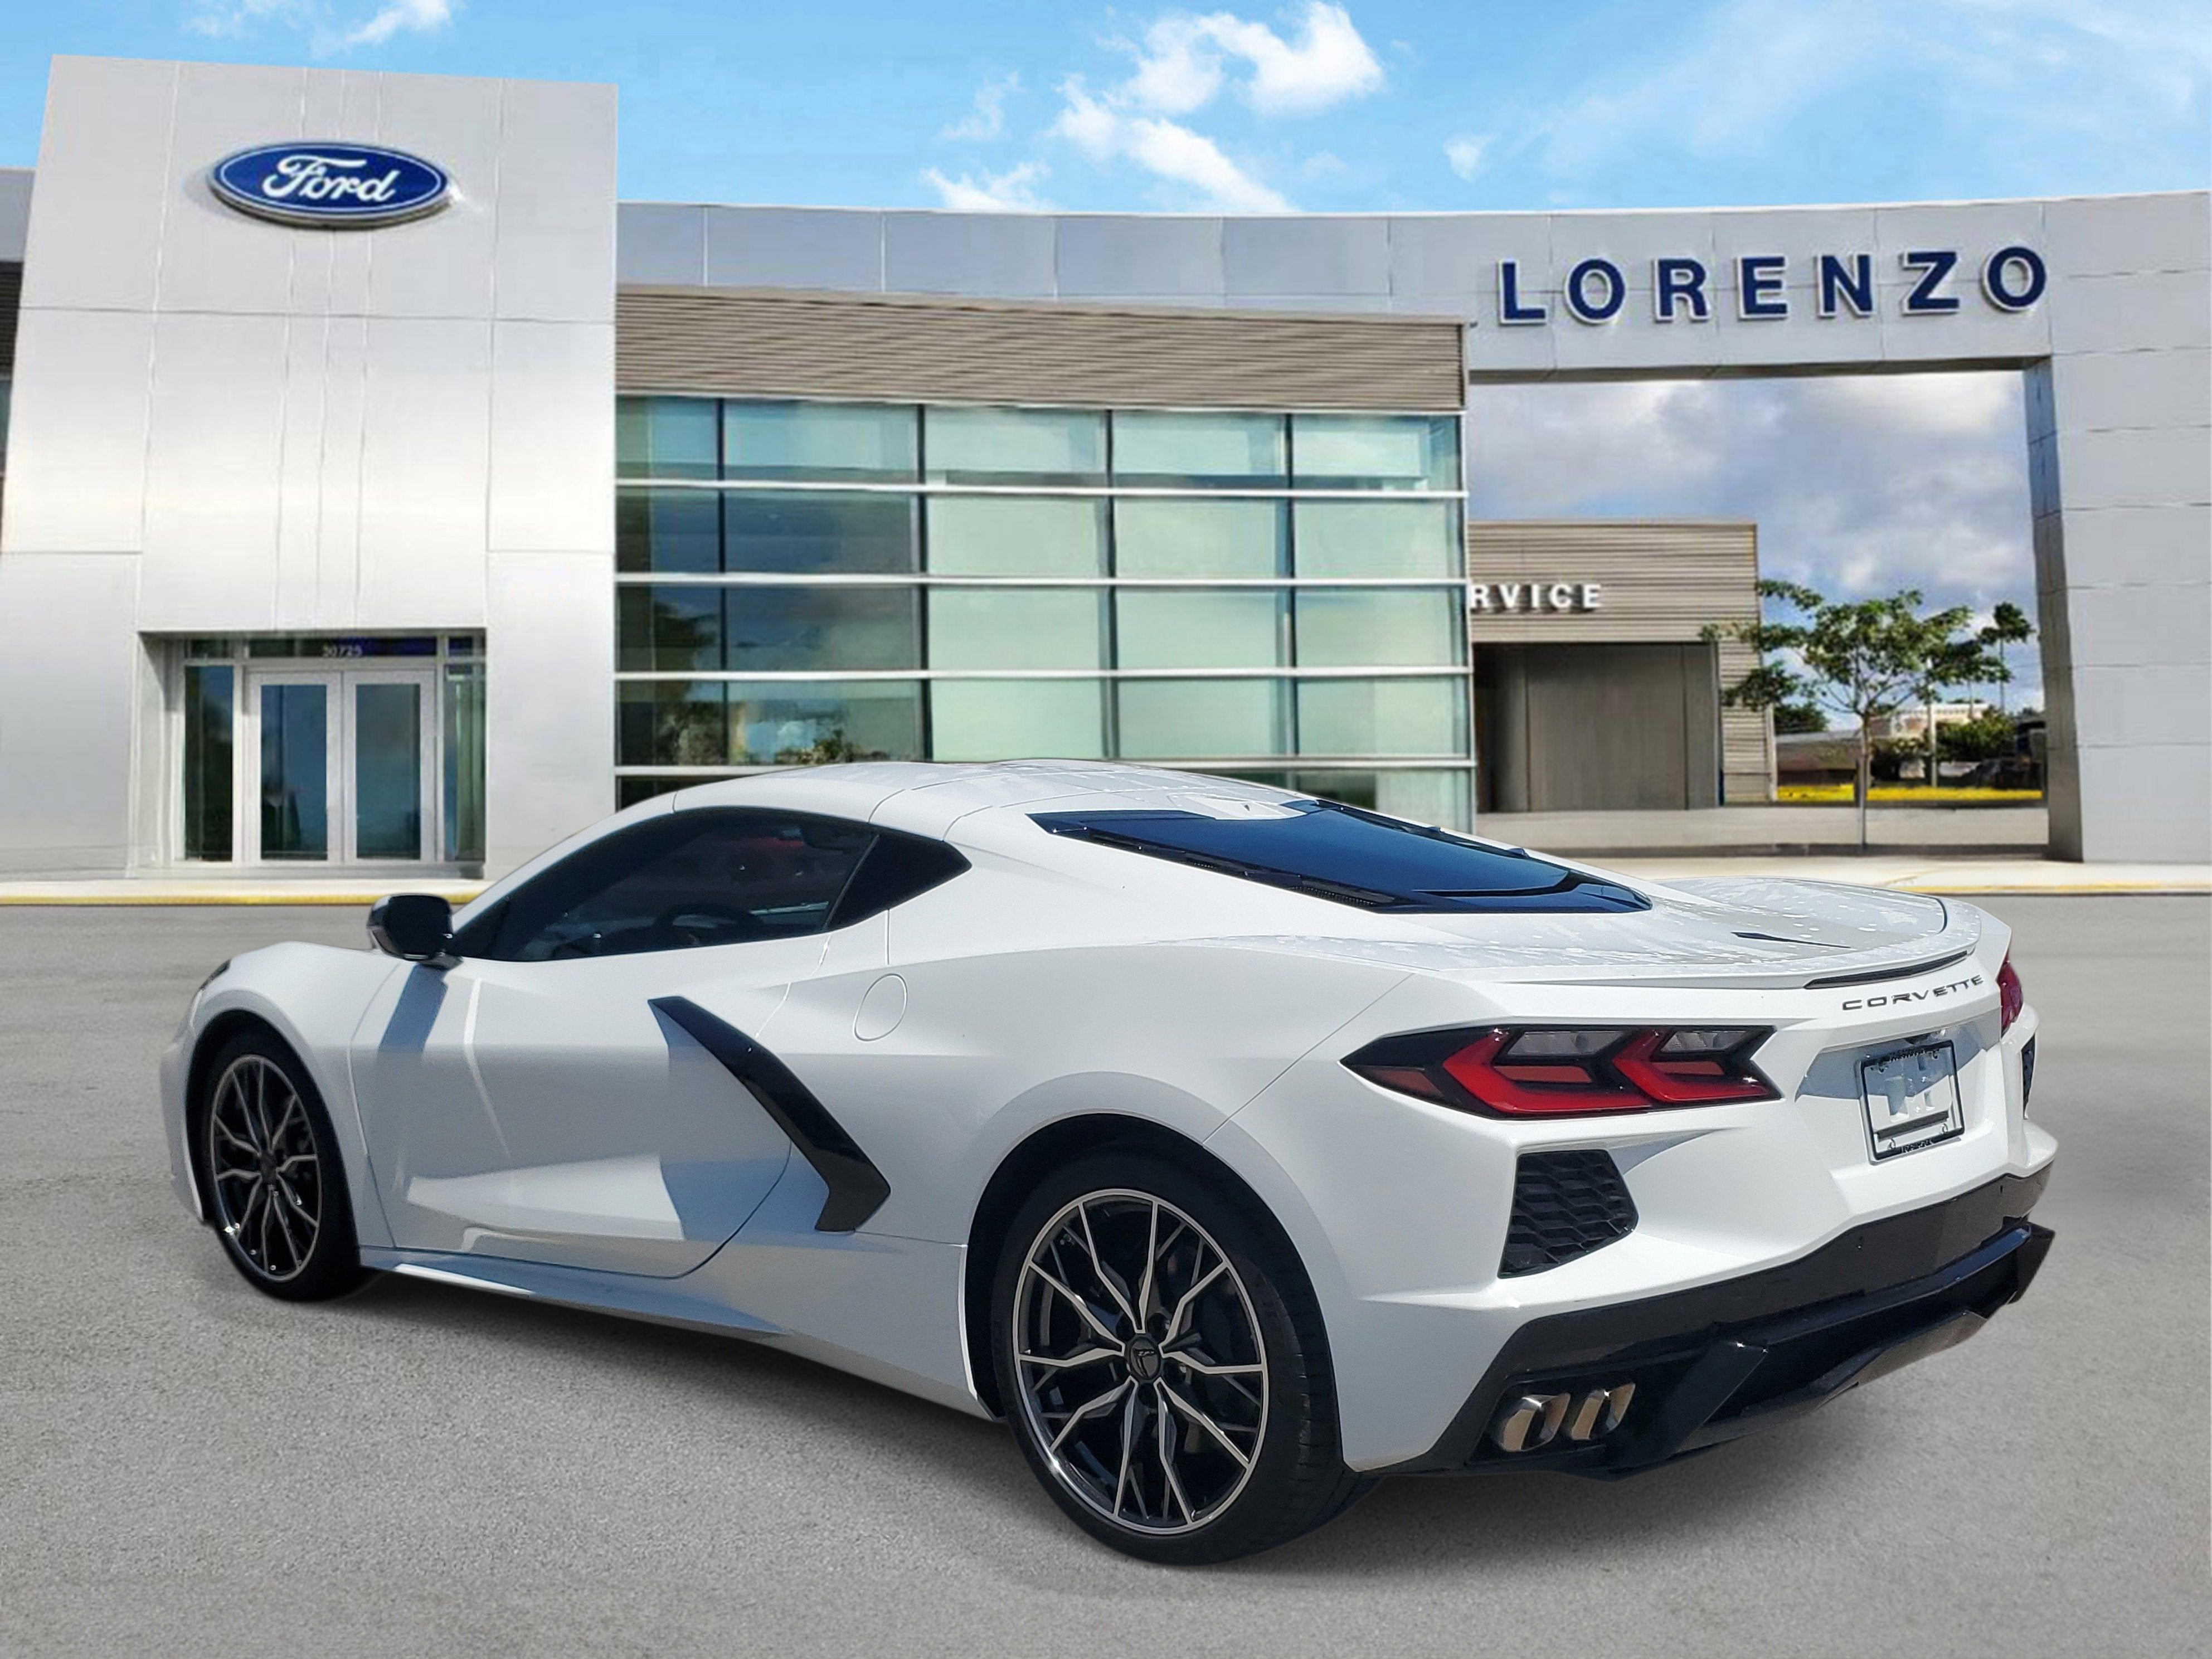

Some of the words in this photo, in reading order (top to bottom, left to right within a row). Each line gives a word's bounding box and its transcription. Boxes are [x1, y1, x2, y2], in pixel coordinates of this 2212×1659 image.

[262, 154, 401, 202] Ford
[1499, 247, 2046, 324] LORENZO
[1842, 974, 1983, 1011] CORVETTE
